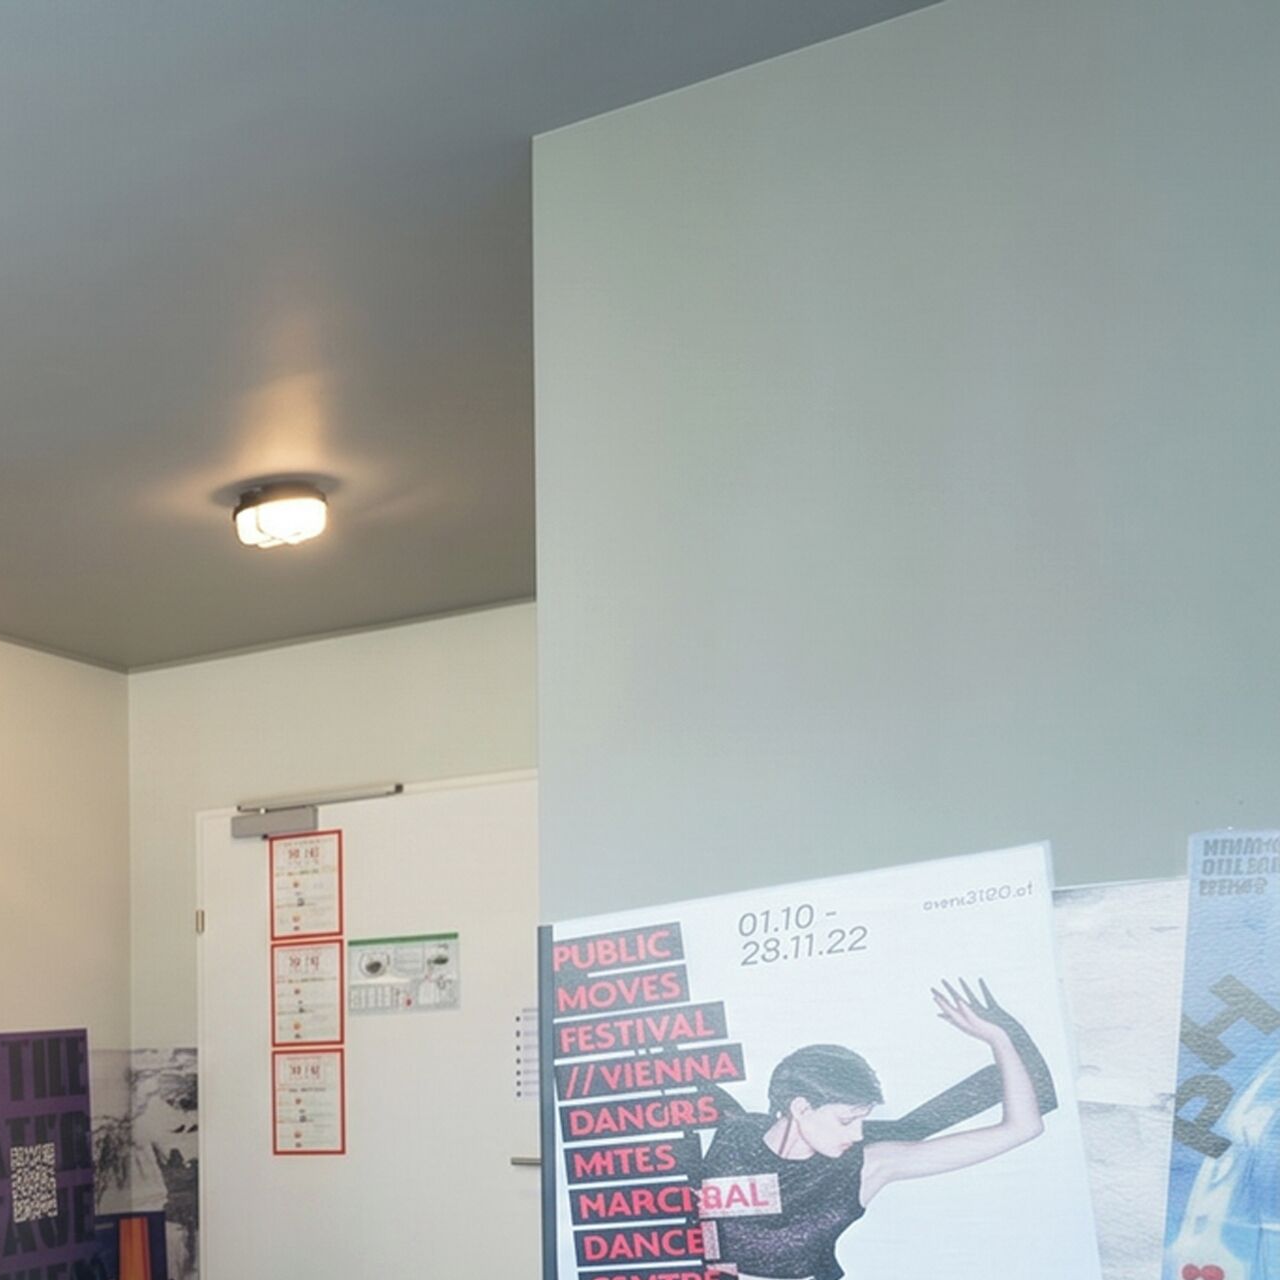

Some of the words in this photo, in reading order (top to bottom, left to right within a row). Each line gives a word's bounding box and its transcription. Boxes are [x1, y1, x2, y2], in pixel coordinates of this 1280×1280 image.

[739, 903, 814, 937] 01.10
[553, 930, 672, 972] PUBLIC
[741, 926, 868, 966] 28.11.22
[557, 972, 681, 1012] MOVES
[560, 1009, 715, 1053] FESTIVAL
[584, 1229, 706, 1261] DANCE
